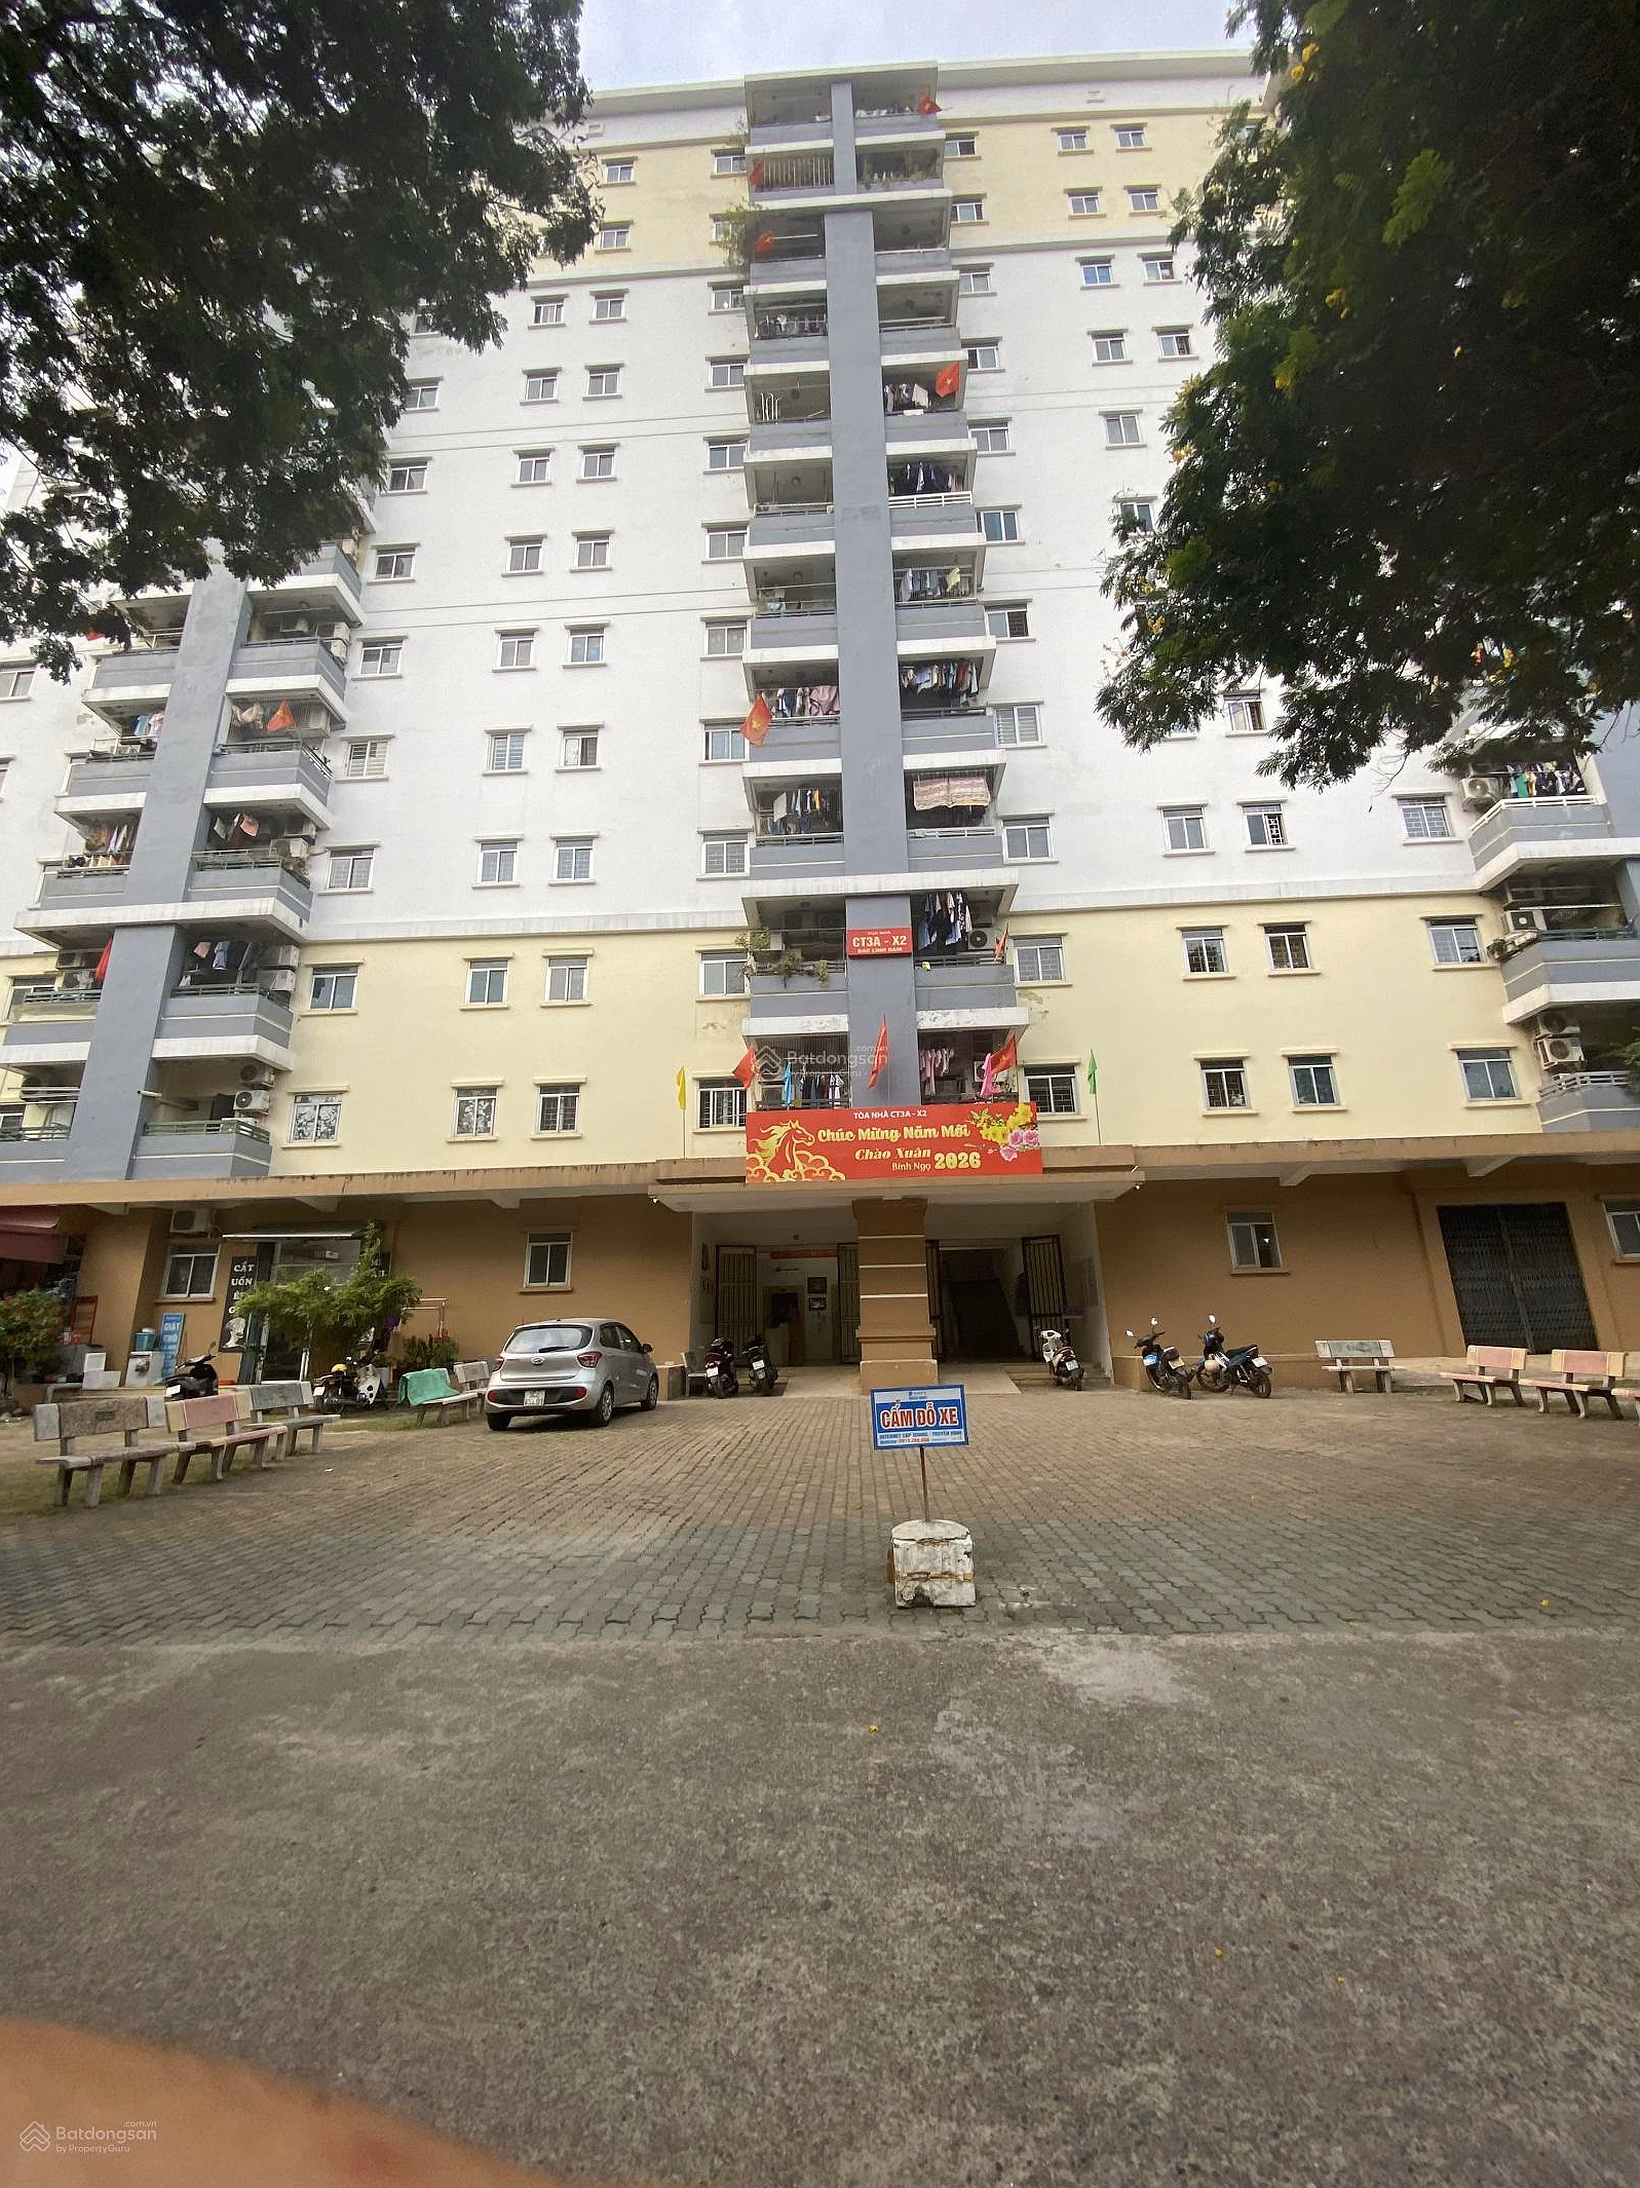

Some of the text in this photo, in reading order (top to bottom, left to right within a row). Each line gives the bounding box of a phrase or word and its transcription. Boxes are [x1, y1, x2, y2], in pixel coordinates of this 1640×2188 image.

[852, 936, 881, 947] CT3A
[891, 935, 907, 946] X2
[853, 1111, 871, 1120] TÒA
[871, 1110, 889, 1119] NHÀ
[890, 1110, 912, 1118] CT3A
[917, 1109, 928, 1117] X2
[817, 1124, 971, 1143] Chúc Mừng Năm Mới
[854, 1147, 932, 1161] Chào Xuân
[933, 1152, 982, 1170] 2026
[891, 1162, 932, 1173] Bính Ngọ
[233, 1261, 255, 1273] CẮT
[231, 1275, 253, 1286] UỐN
[881, 1402, 959, 1430] CẤM ĐỖ XE
